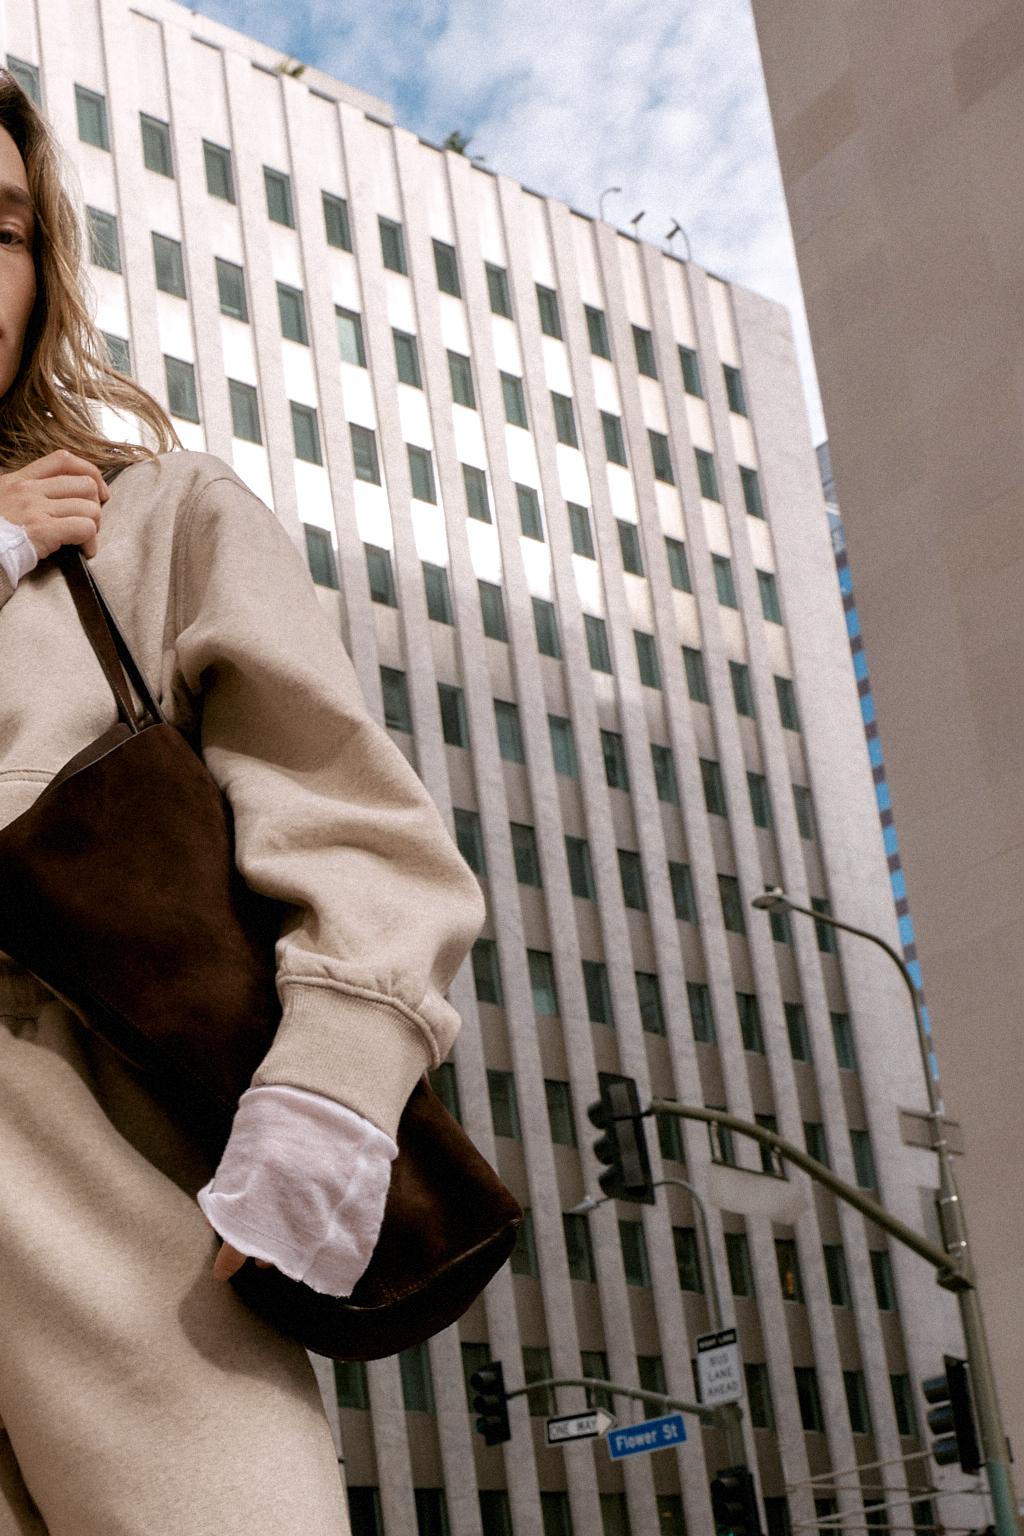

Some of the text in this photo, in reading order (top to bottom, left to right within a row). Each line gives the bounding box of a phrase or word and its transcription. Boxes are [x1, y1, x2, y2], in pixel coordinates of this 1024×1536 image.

[709, 1353, 729, 1367] BUS
[708, 1367, 733, 1382] LANE
[707, 1381, 739, 1396] AHEAD
[549, 1418, 597, 1439] ONE WAY
[615, 1423, 679, 1450] Flower St
